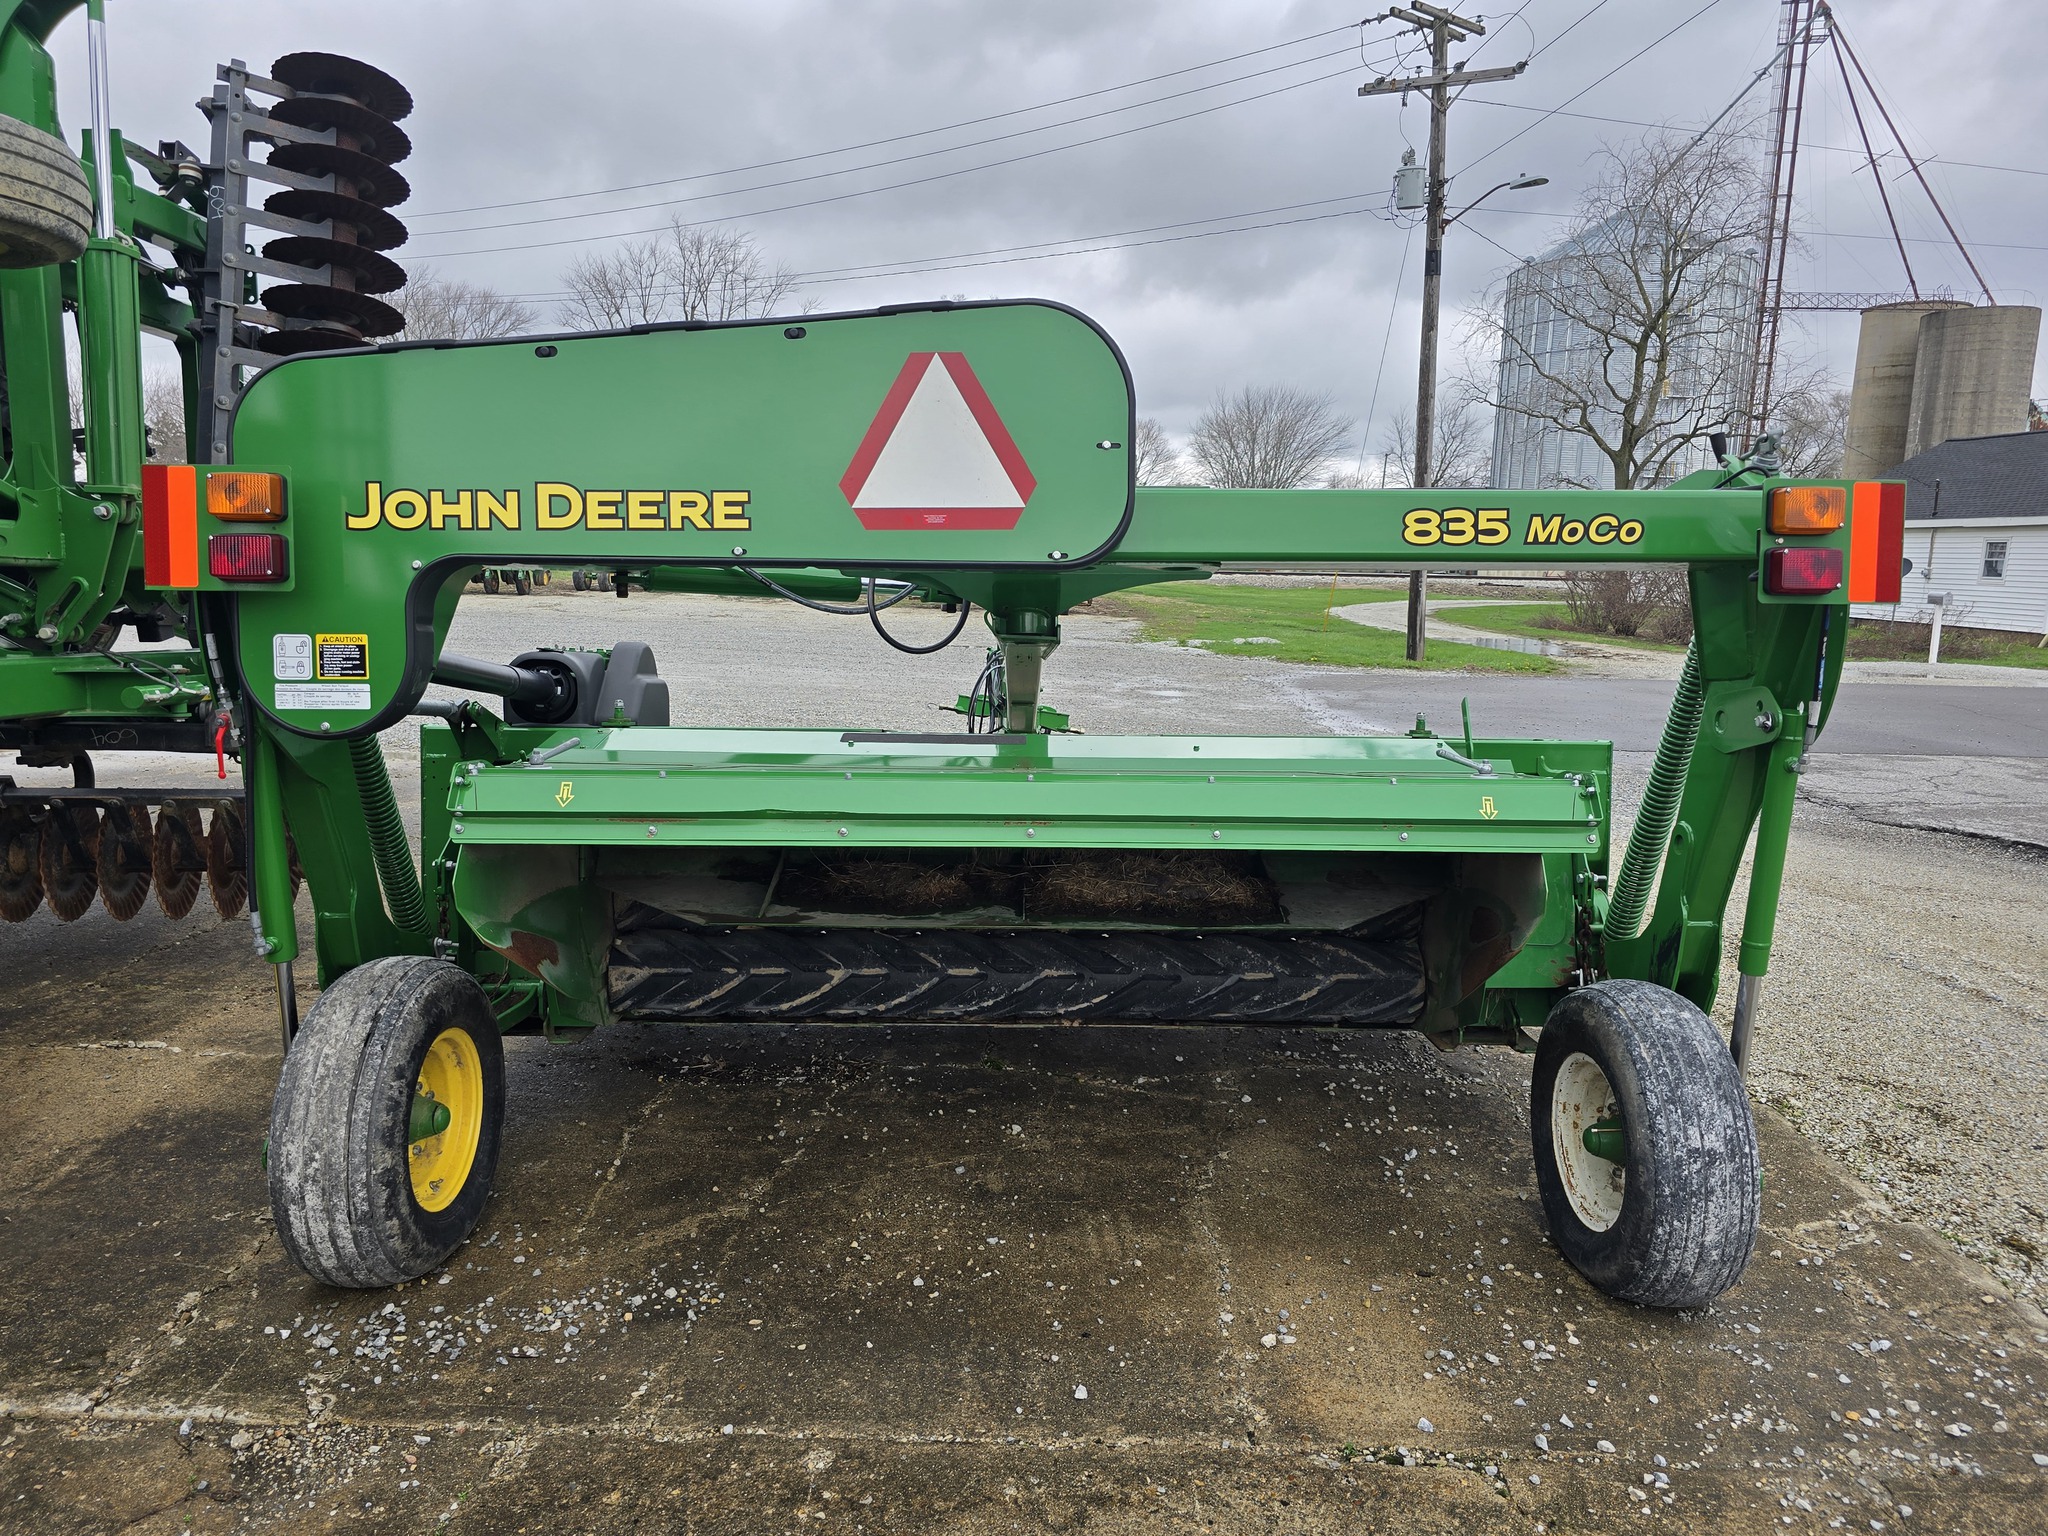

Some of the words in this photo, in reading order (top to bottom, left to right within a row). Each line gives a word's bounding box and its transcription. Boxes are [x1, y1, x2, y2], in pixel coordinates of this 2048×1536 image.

[345, 481, 521, 531] JOHN
[535, 481, 751, 531] DEERE
[1402, 507, 1511, 546] 835
[1522, 513, 1645, 545] MoCo
